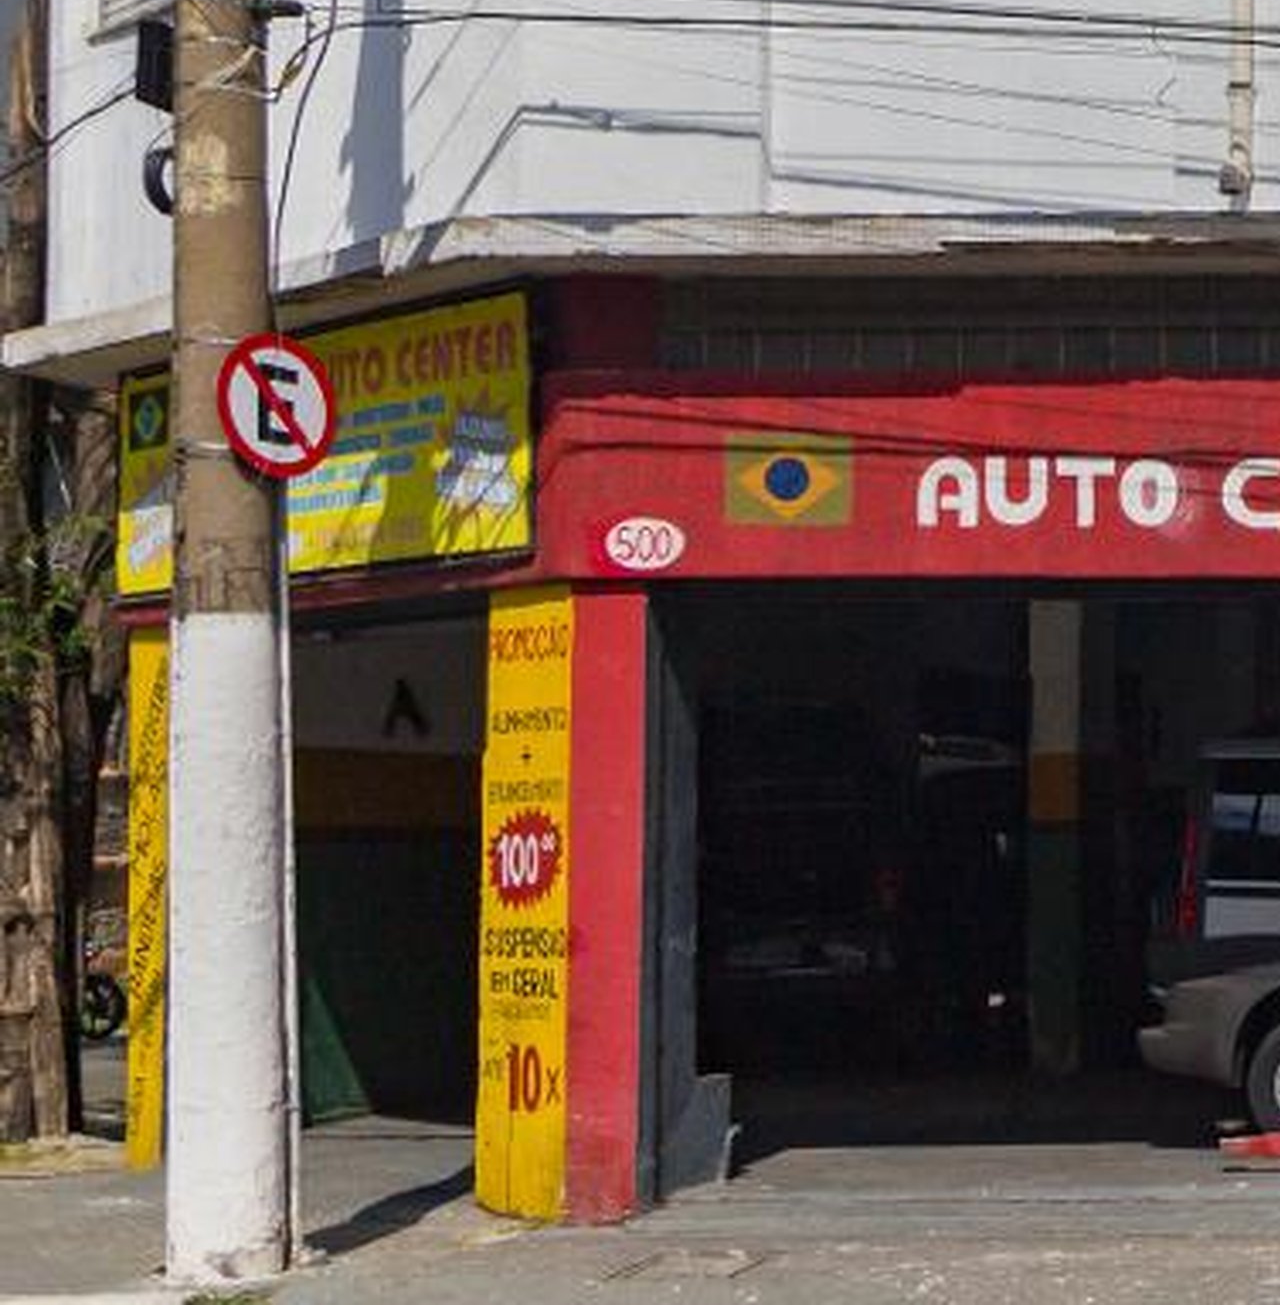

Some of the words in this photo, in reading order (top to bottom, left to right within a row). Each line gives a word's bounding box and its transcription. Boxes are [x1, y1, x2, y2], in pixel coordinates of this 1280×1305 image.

[916, 455, 1180, 529] AUTO
[614, 527, 673, 562] 500
[507, 1042, 542, 1113] 10
